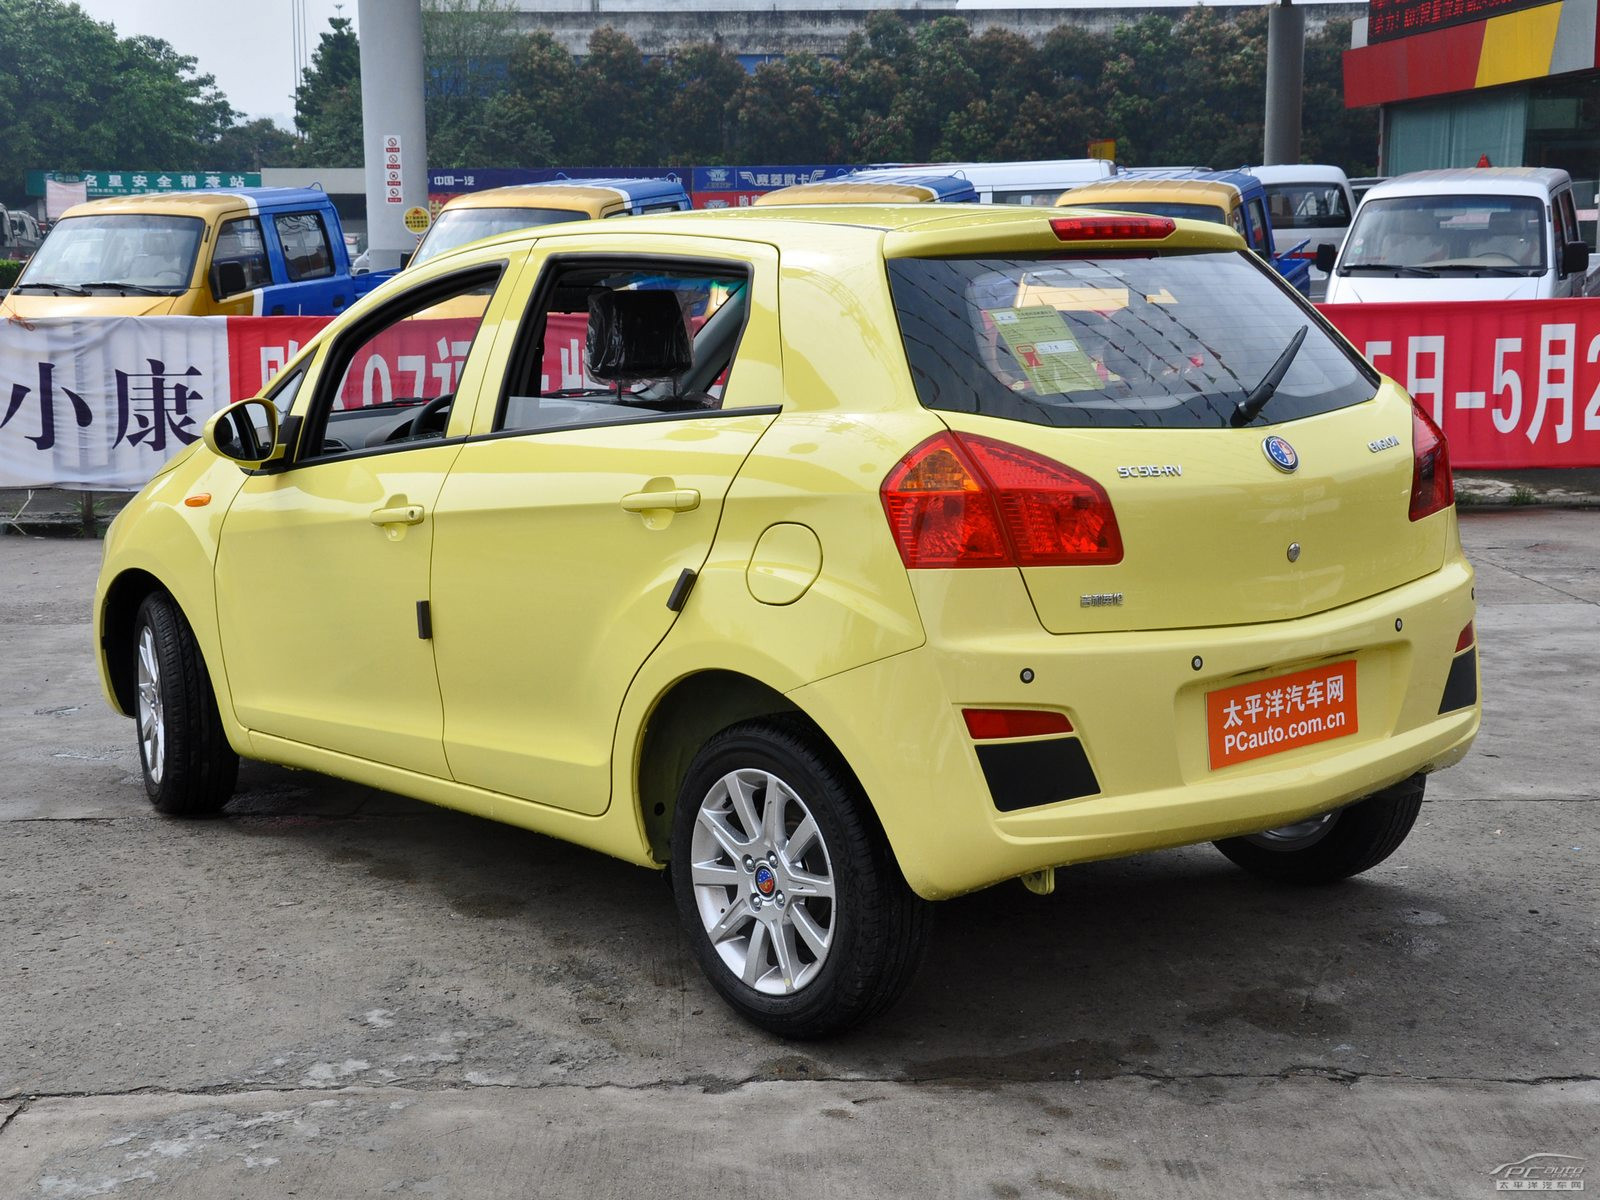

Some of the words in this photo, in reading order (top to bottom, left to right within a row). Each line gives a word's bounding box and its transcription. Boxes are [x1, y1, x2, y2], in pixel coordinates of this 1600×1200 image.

[0, 358, 203, 451] 小康
[1117, 464, 1183, 478] SC515-RV
[1222, 674, 1344, 730] 太平洋汽车网
[1224, 710, 1346, 755] PCauto.com.cn
